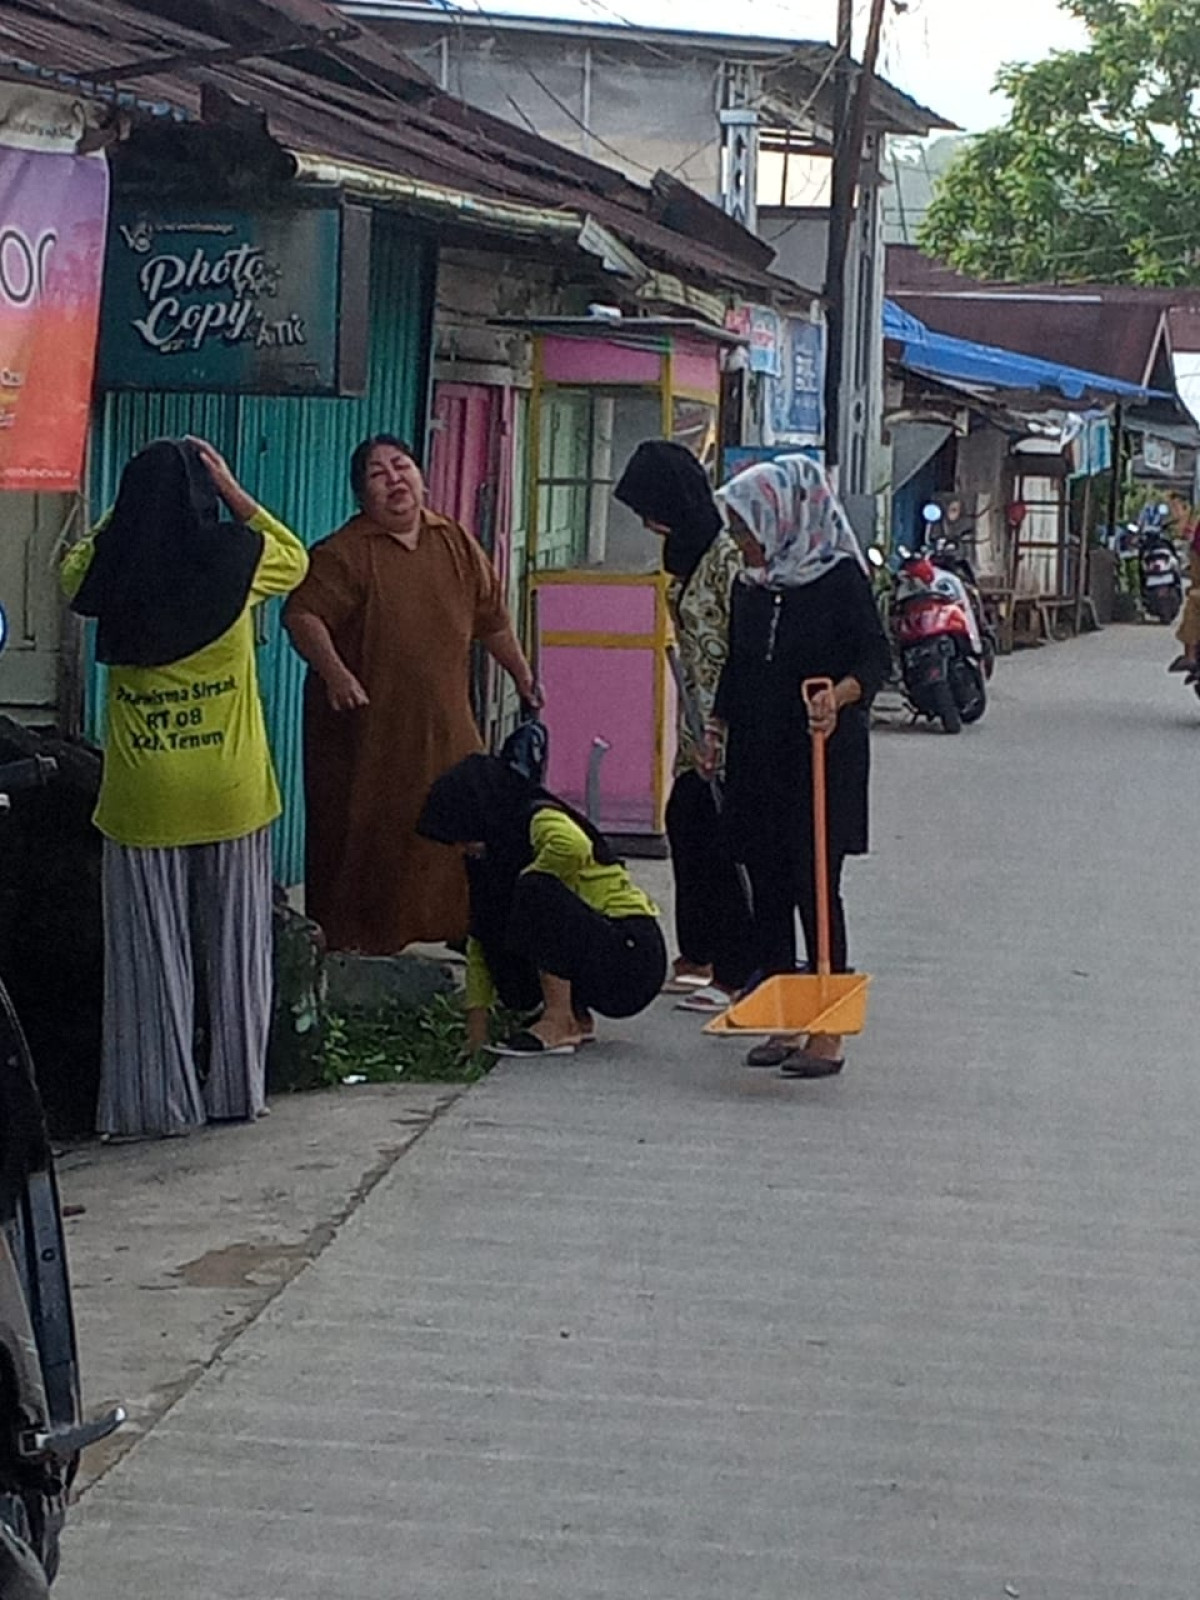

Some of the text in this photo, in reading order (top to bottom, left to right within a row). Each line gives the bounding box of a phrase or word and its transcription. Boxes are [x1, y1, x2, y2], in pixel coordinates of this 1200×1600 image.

[140, 243, 263, 300] Photo
[131, 297, 251, 349] Copy
[146, 707, 203, 729] RT 08
[167, 731, 224, 750] Tenun
